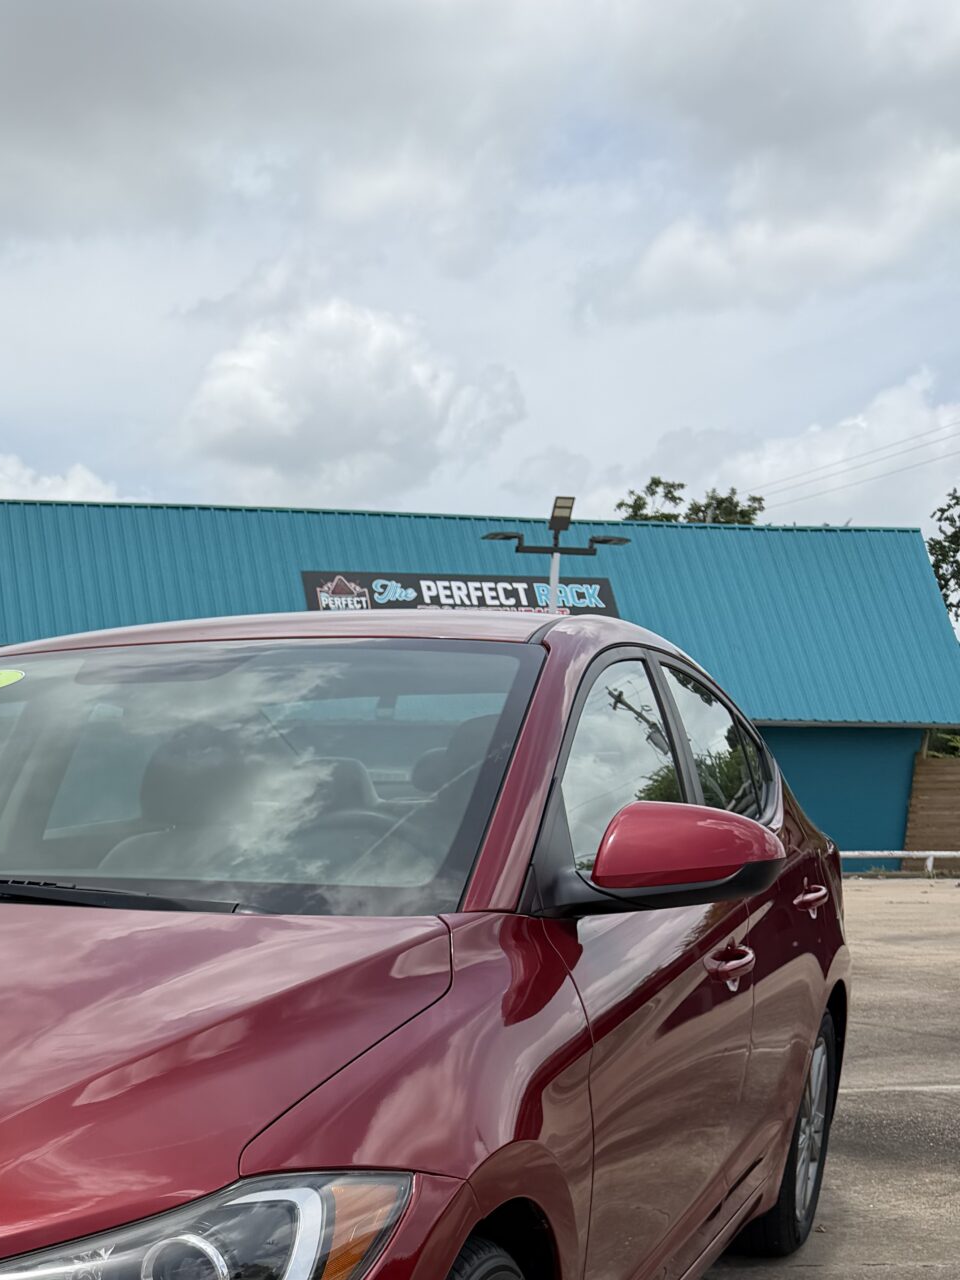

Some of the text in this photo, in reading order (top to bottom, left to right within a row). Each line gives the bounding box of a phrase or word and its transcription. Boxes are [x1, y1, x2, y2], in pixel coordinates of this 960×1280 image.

[321, 592, 368, 609] PERFECT
[372, 579, 417, 604] The
[419, 580, 529, 606] PERFECT
